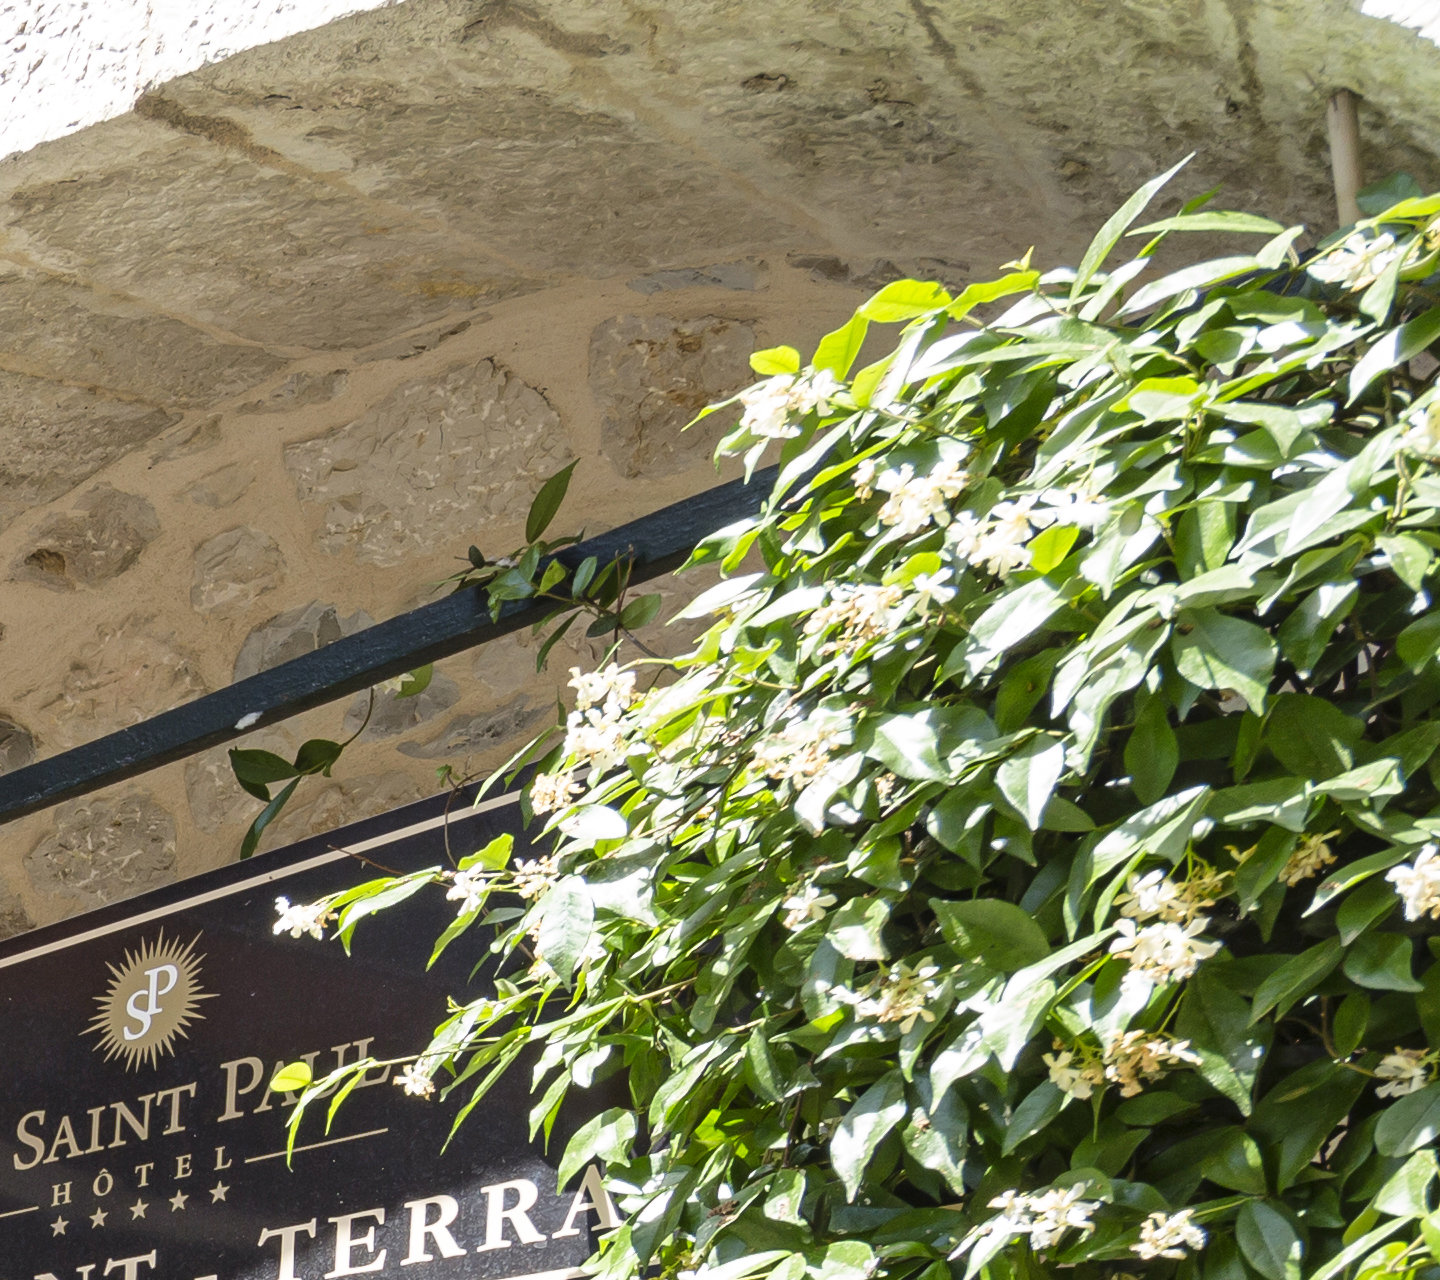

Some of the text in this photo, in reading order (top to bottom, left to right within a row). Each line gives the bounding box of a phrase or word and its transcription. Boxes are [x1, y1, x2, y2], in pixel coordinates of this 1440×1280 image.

[12, 1081, 198, 1171] SAINT
[216, 1036, 392, 1123] PAUL
[49, 1145, 234, 1208] HÔTEL
